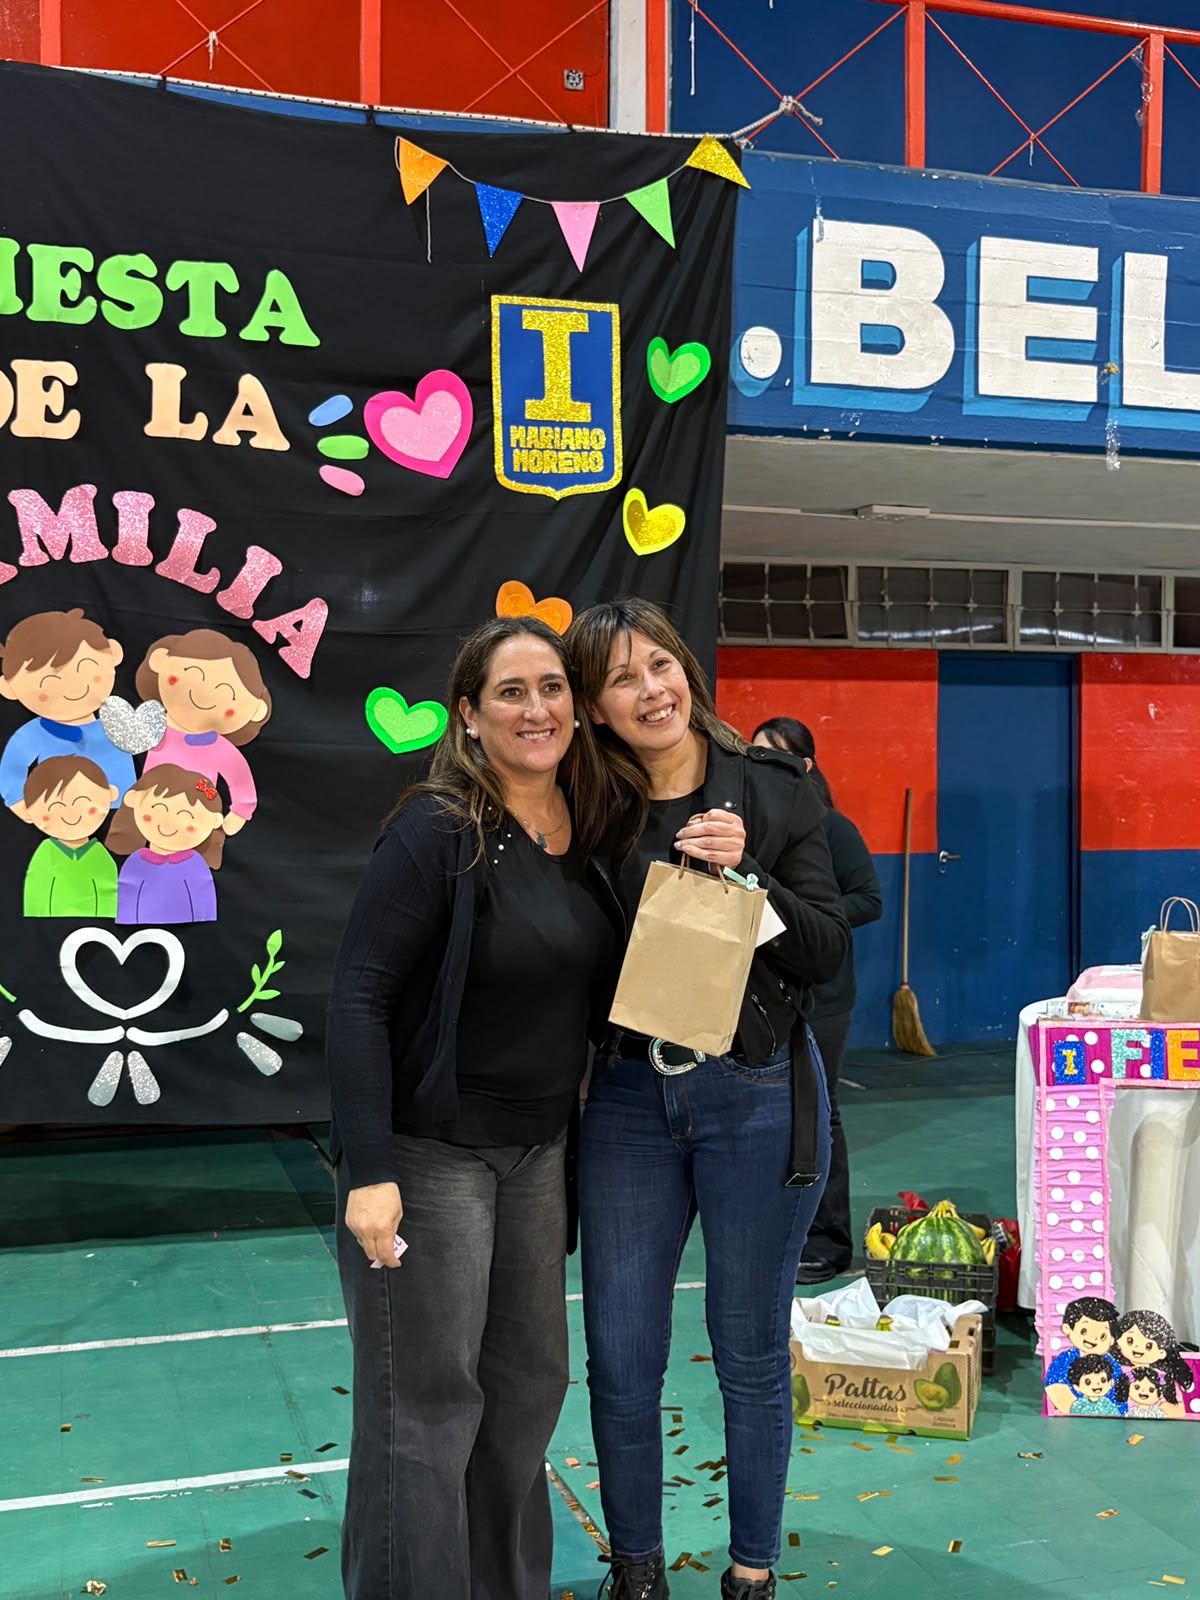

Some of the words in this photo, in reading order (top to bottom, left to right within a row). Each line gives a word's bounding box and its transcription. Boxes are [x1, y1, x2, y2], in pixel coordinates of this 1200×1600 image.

[521, 308, 592, 423] I
[0, 359, 81, 440] E
[144, 362, 291, 452] LA
[509, 425, 607, 451] MARIANO
[512, 449, 605, 474] MORENO
[0, 484, 329, 679] MILIA
[824, 1373, 907, 1402] Paltas
[833, 1398, 899, 1413] seleccionadas
